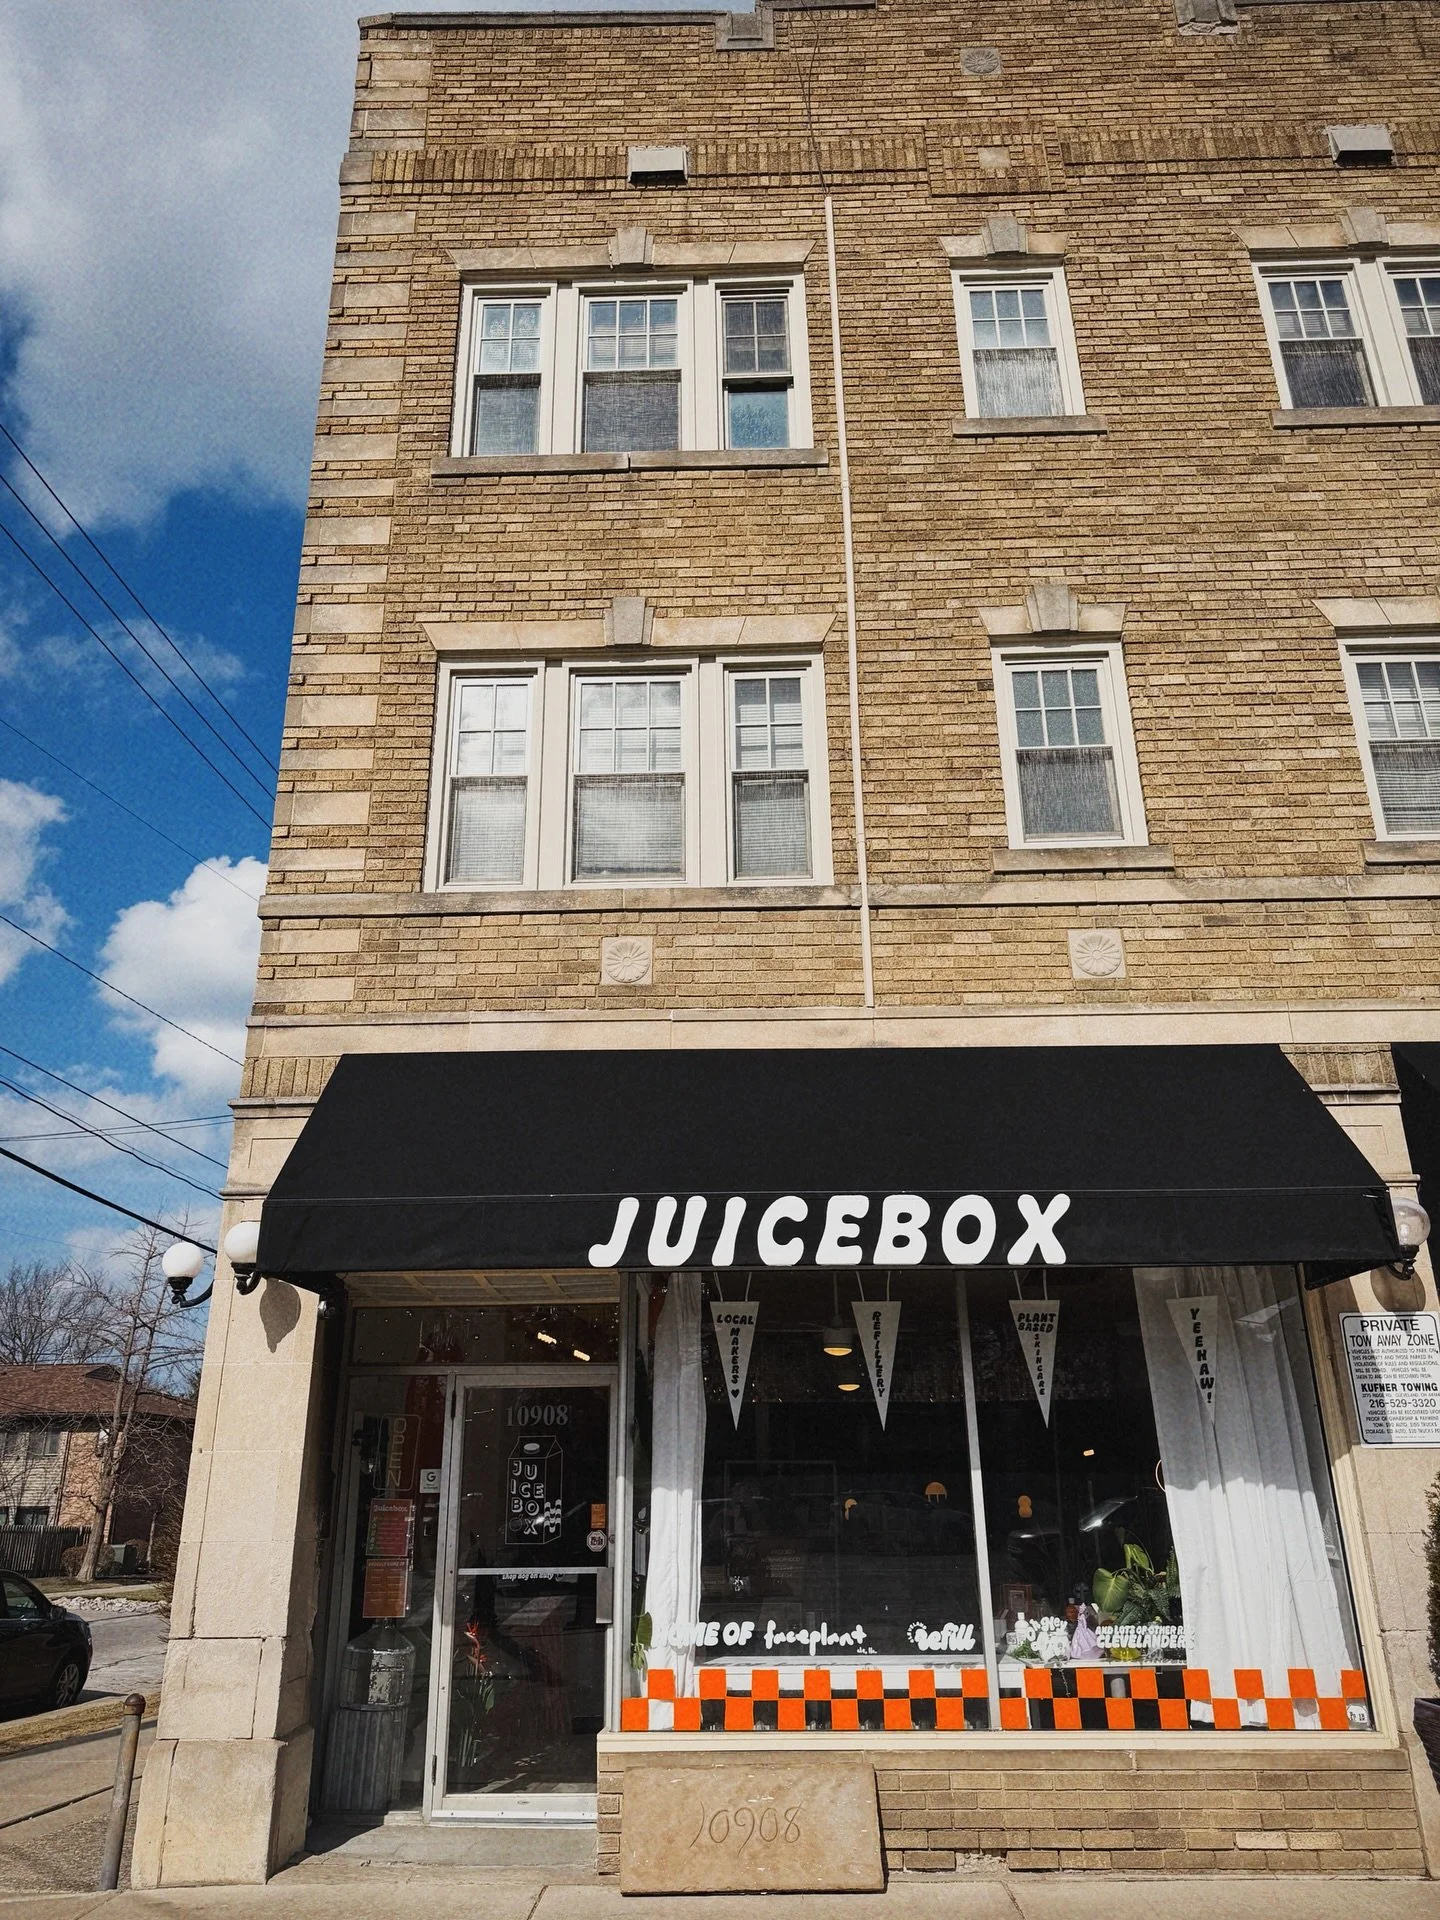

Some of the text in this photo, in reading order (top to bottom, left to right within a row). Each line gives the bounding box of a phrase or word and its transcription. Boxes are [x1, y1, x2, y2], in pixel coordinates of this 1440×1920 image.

[588, 1193, 1071, 1267] JUICEBOX
[717, 1314, 754, 1325] LOCAL
[1017, 1312, 1056, 1323] PLANT
[1017, 1322, 1054, 1333] BASED
[1360, 1319, 1420, 1331] PRIVATE
[1350, 1334, 1435, 1347] TOW AWAY ZONE
[730, 1327, 740, 1384] MAKERS
[872, 1311, 885, 1397] REFILLERY
[1034, 1333, 1045, 1395] SKINCARE
[1190, 1308, 1214, 1404] YEEHAW!
[1361, 1383, 1438, 1392] KUFNER TOWING
[1369, 1399, 1436, 1408] 216-529-3320
[504, 1404, 568, 1426] 10908
[386, 1417, 407, 1487] OPEN
[722, 1621, 755, 1646] OF
[764, 1620, 867, 1656] faceplant
[1095, 1625, 1113, 1635] AND
[1114, 1625, 1135, 1635] LOTS
[1136, 1625, 1147, 1635] OF
[1148, 1625, 1177, 1635] OTHER
[689, 1800, 804, 1856] 10908
